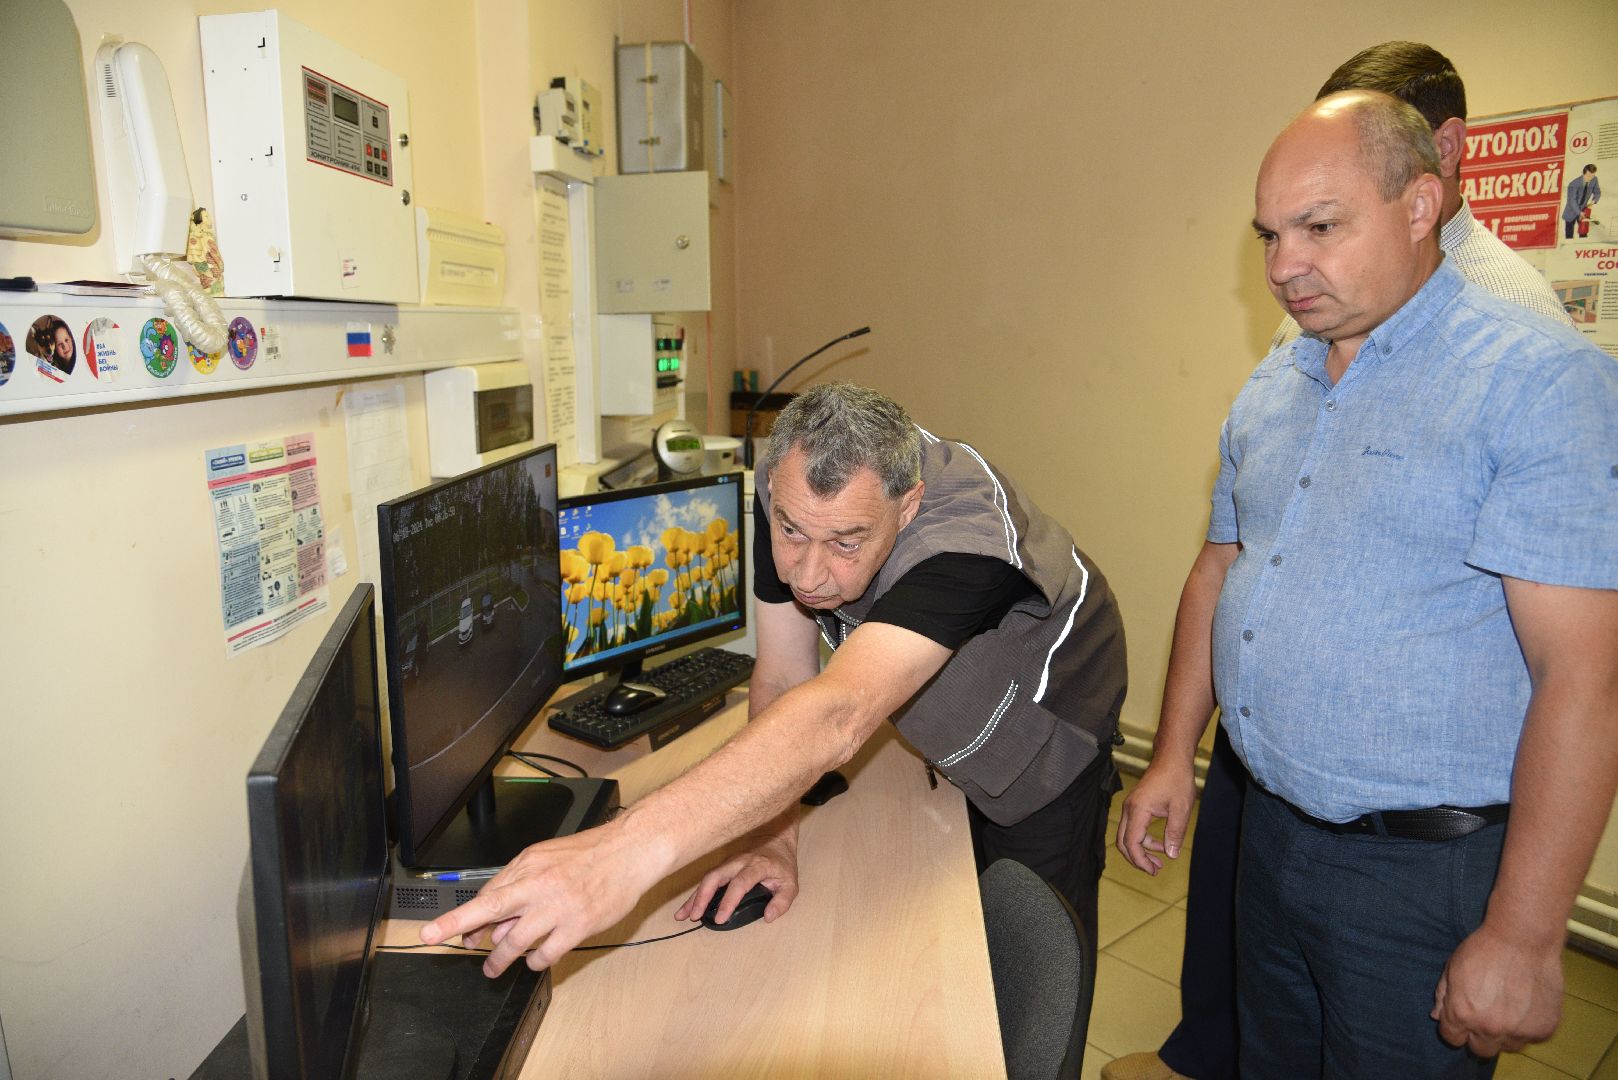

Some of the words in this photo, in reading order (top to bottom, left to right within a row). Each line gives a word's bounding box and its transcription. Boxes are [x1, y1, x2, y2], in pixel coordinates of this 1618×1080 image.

[1466, 123, 1559, 160] УГОЛОК
[1572, 136, 1588, 148] 01
[1460, 163, 1561, 201] АНСКОЙ
[1597, 260, 1618, 270] СО
